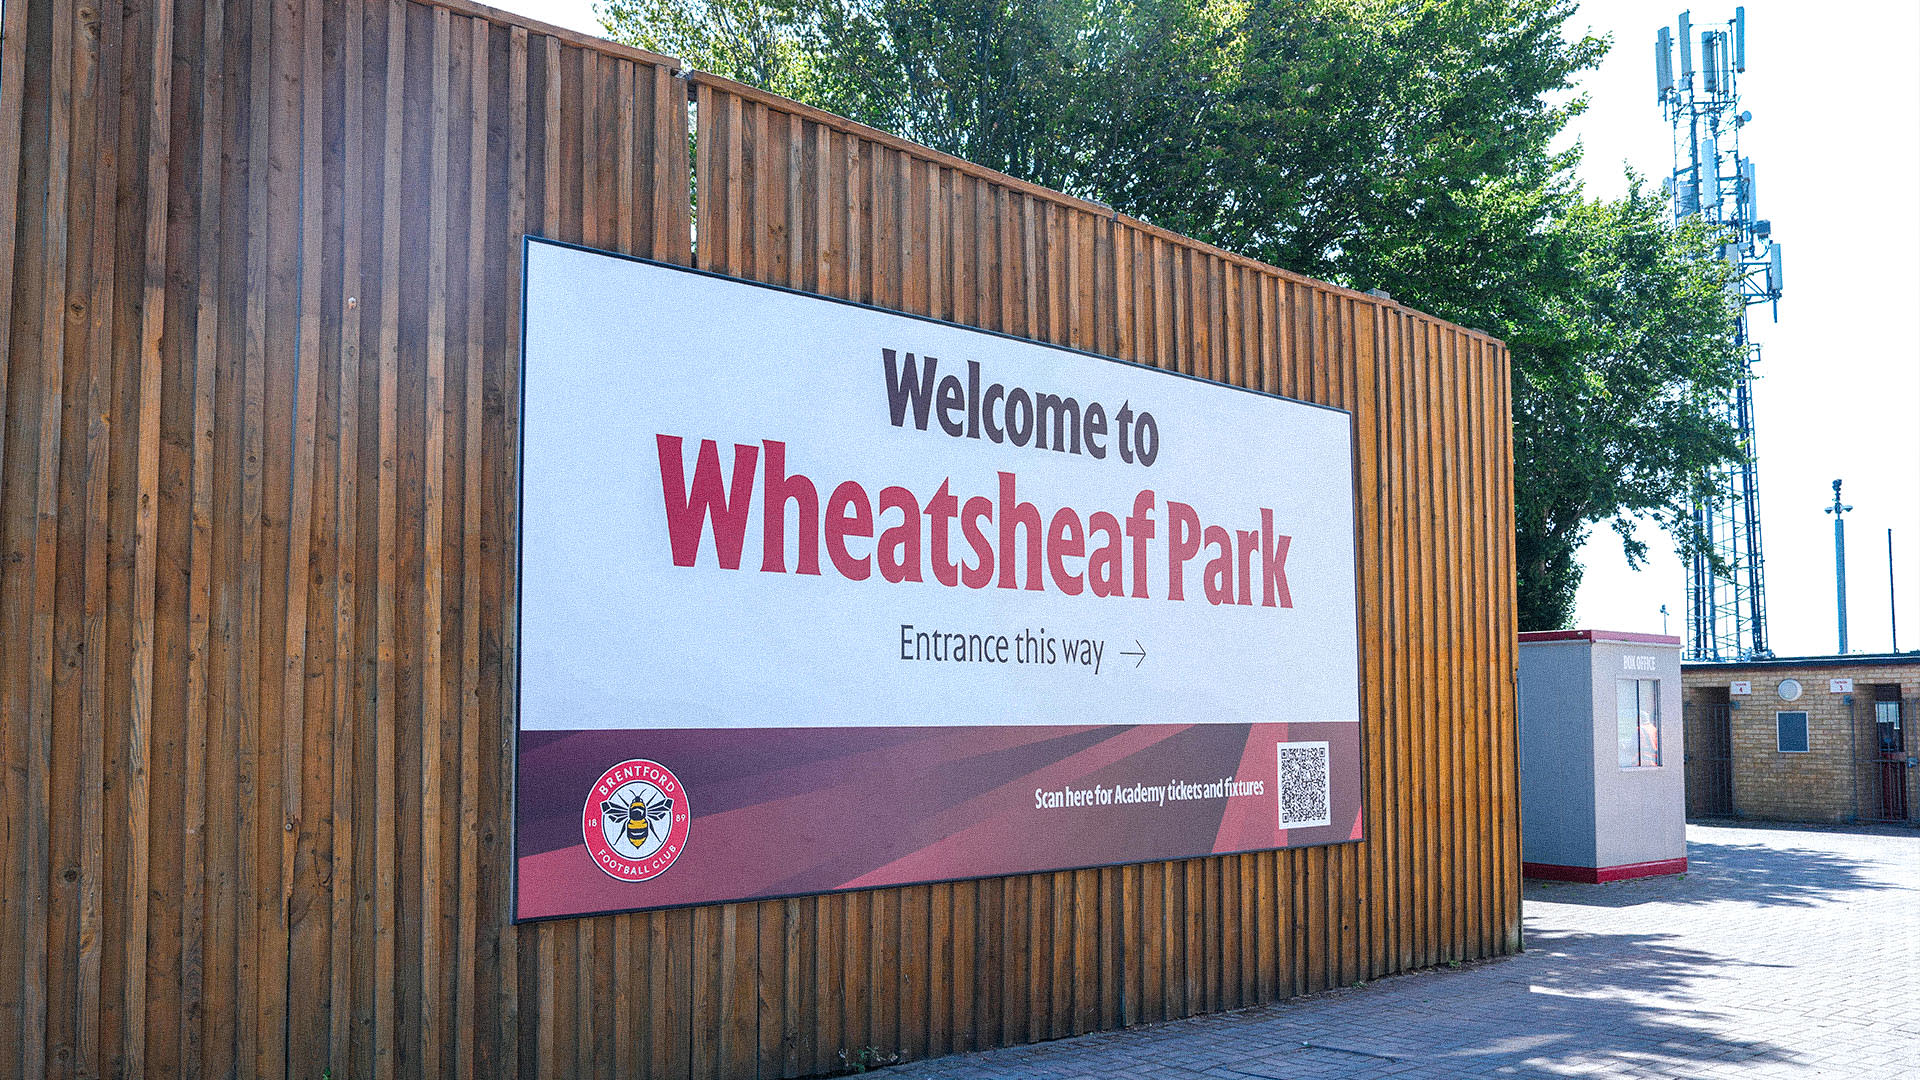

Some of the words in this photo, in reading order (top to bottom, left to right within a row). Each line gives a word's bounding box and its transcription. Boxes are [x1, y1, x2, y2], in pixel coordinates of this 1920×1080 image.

[881, 348, 1109, 460] Welcome
[1115, 399, 1160, 468] to
[655, 433, 1156, 599] Wheatsheaf
[1165, 500, 1294, 609] Park
[900, 624, 1009, 664] Entrance
[1014, 627, 1057, 665] this
[1062, 638, 1105, 675] way
[1623, 655, 1636, 670] BOX
[1636, 655, 1656, 671] OFFICE
[598, 765, 675, 796] BRENTFORD
[1035, 788, 1064, 809] Scan
[1065, 786, 1094, 807] here
[1094, 784, 1114, 805] for
[1114, 782, 1166, 807] Academy
[1167, 779, 1202, 801] tickets
[1203, 778, 1223, 799] and
[1224, 775, 1264, 798] fixtures
[588, 818, 598, 828] 18
[675, 814, 686, 822] 89
[598, 849, 650, 876] FOOTBALL
[652, 845, 677, 870] CLUB
